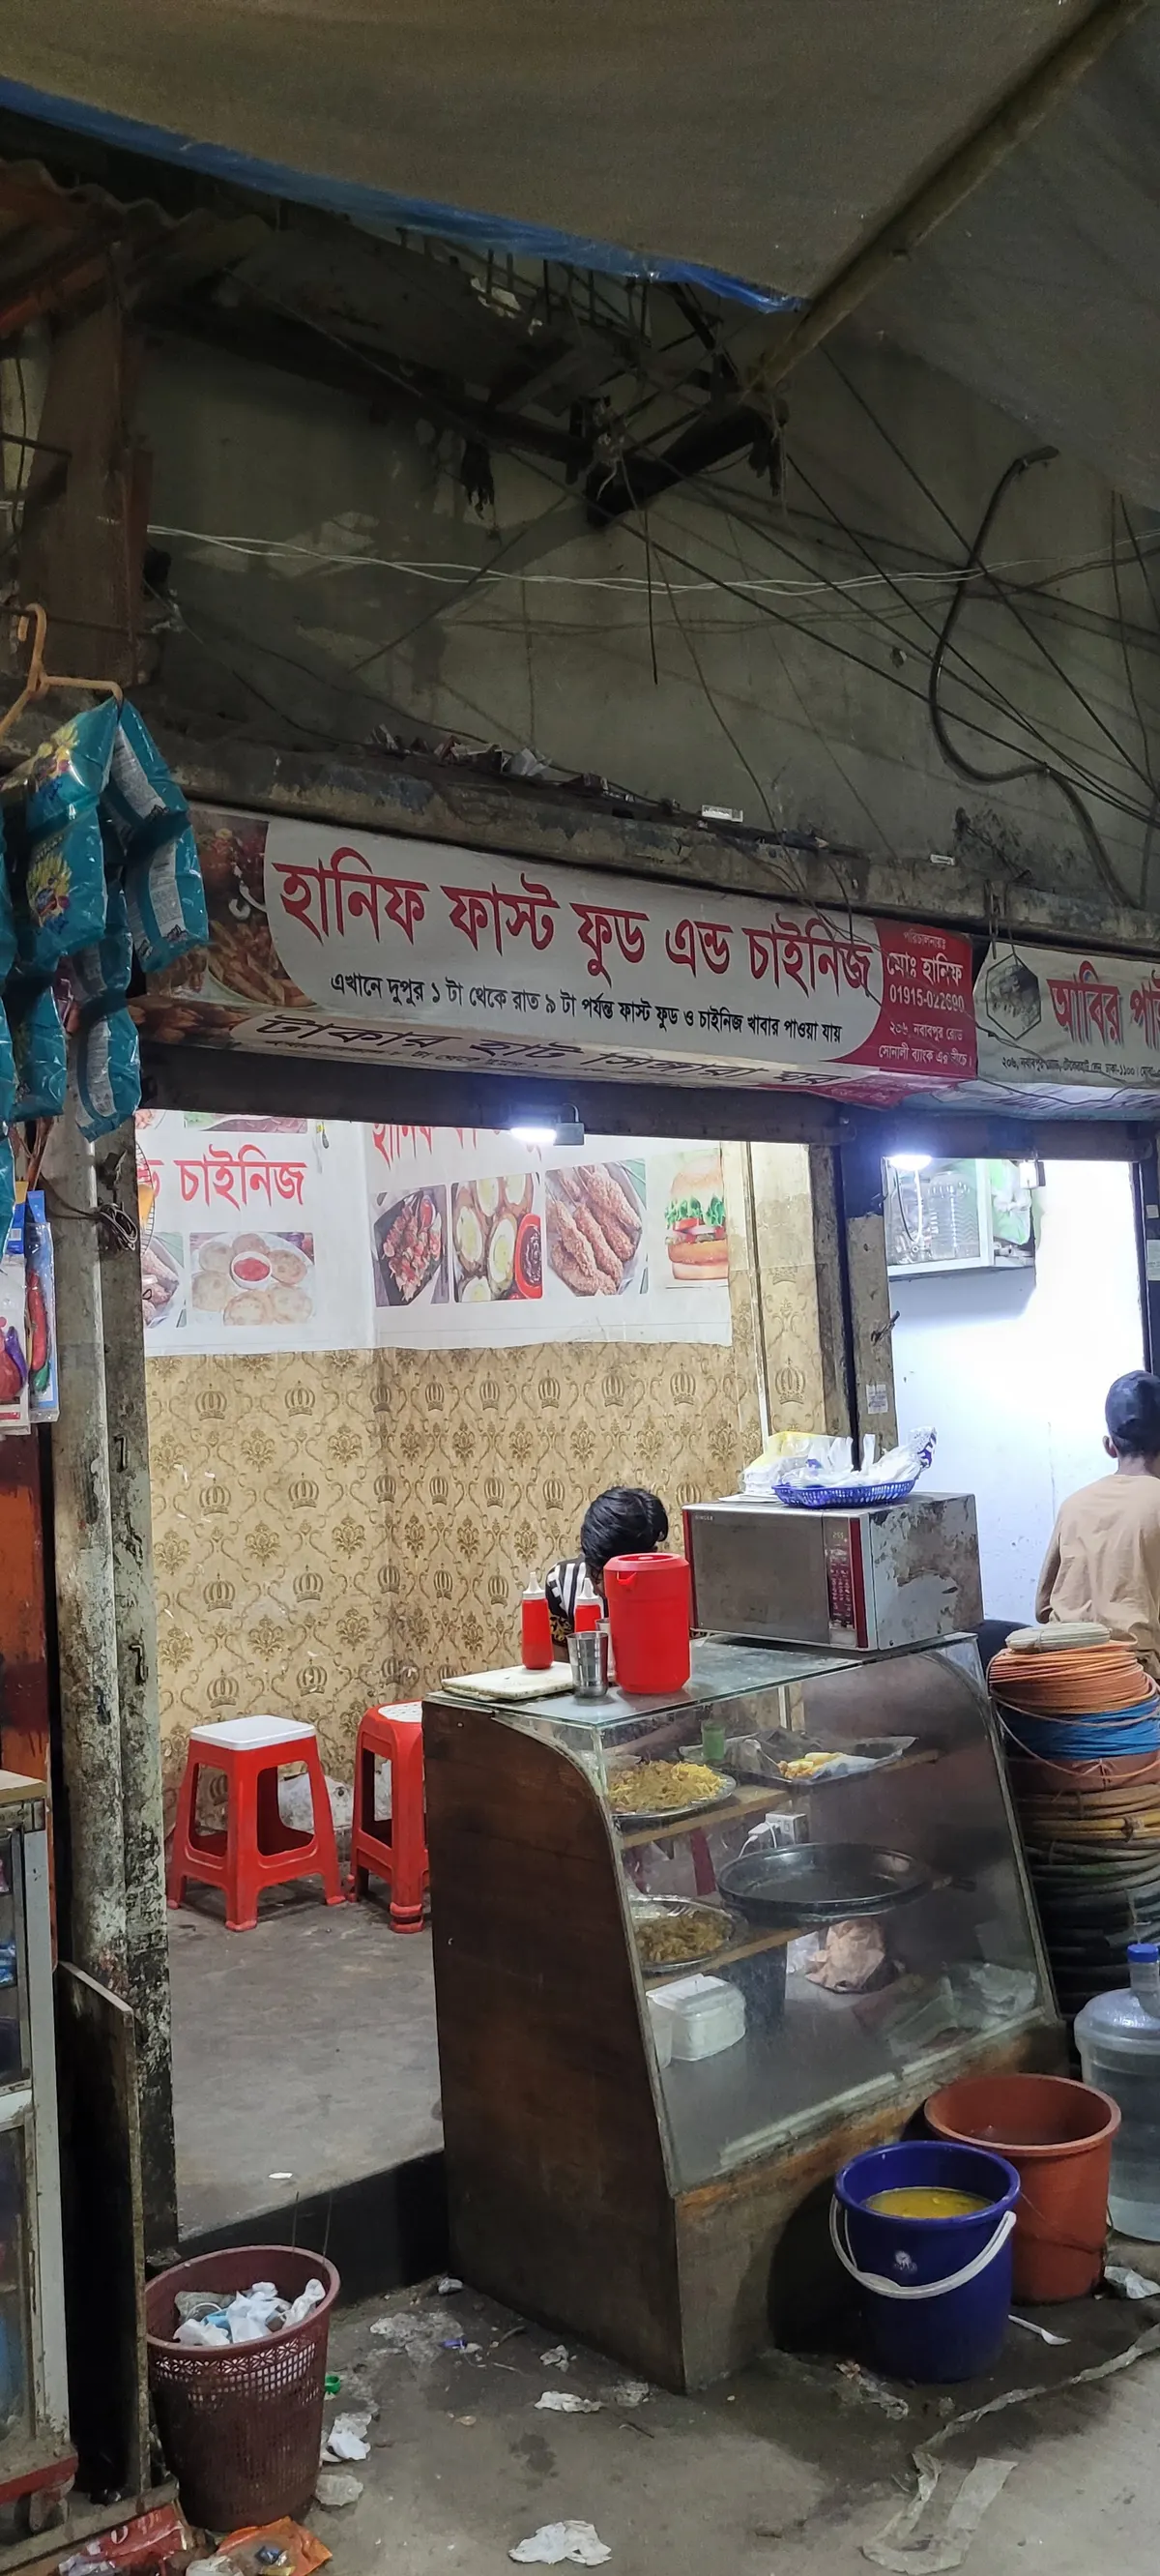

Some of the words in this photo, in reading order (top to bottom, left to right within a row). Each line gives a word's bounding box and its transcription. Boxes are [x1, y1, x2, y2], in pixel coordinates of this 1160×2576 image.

[272, 847, 430, 946] হানিফ
[440, 872, 561, 955] ফাস্ট
[569, 902, 650, 987] ফুড
[665, 919, 734, 978] এন্ড
[741, 913, 873, 997] চাইনিজ
[886, 951, 916, 979] মোঃ
[920, 952, 964, 987] হানিফ
[331, 973, 383, 998] এখানে
[387, 978, 423, 1006] দুপুর
[431, 982, 441, 1003] ১
[446, 977, 463, 1006] টা
[469, 985, 508, 1010] থেকে
[511, 990, 539, 1012] রাত
[546, 994, 556, 1013] ৯
[561, 988, 577, 1017] টা
[582, 992, 614, 1019] পর্যন্ত
[618, 997, 652, 1023] ফাস্ট
[655, 1005, 679, 1032] ফুড
[683, 1010, 694, 1027] ও
[698, 1005, 743, 1033] চাইনিজ
[747, 1013, 780, 1037] খাবার
[784, 1018, 819, 1041] পাওয়া
[822, 1023, 842, 1044] যায়
[1130, 970, 1160, 1051] পা
[469, 1038, 584, 1059] হাট
[174, 1144, 307, 1211] চাইনিজ
